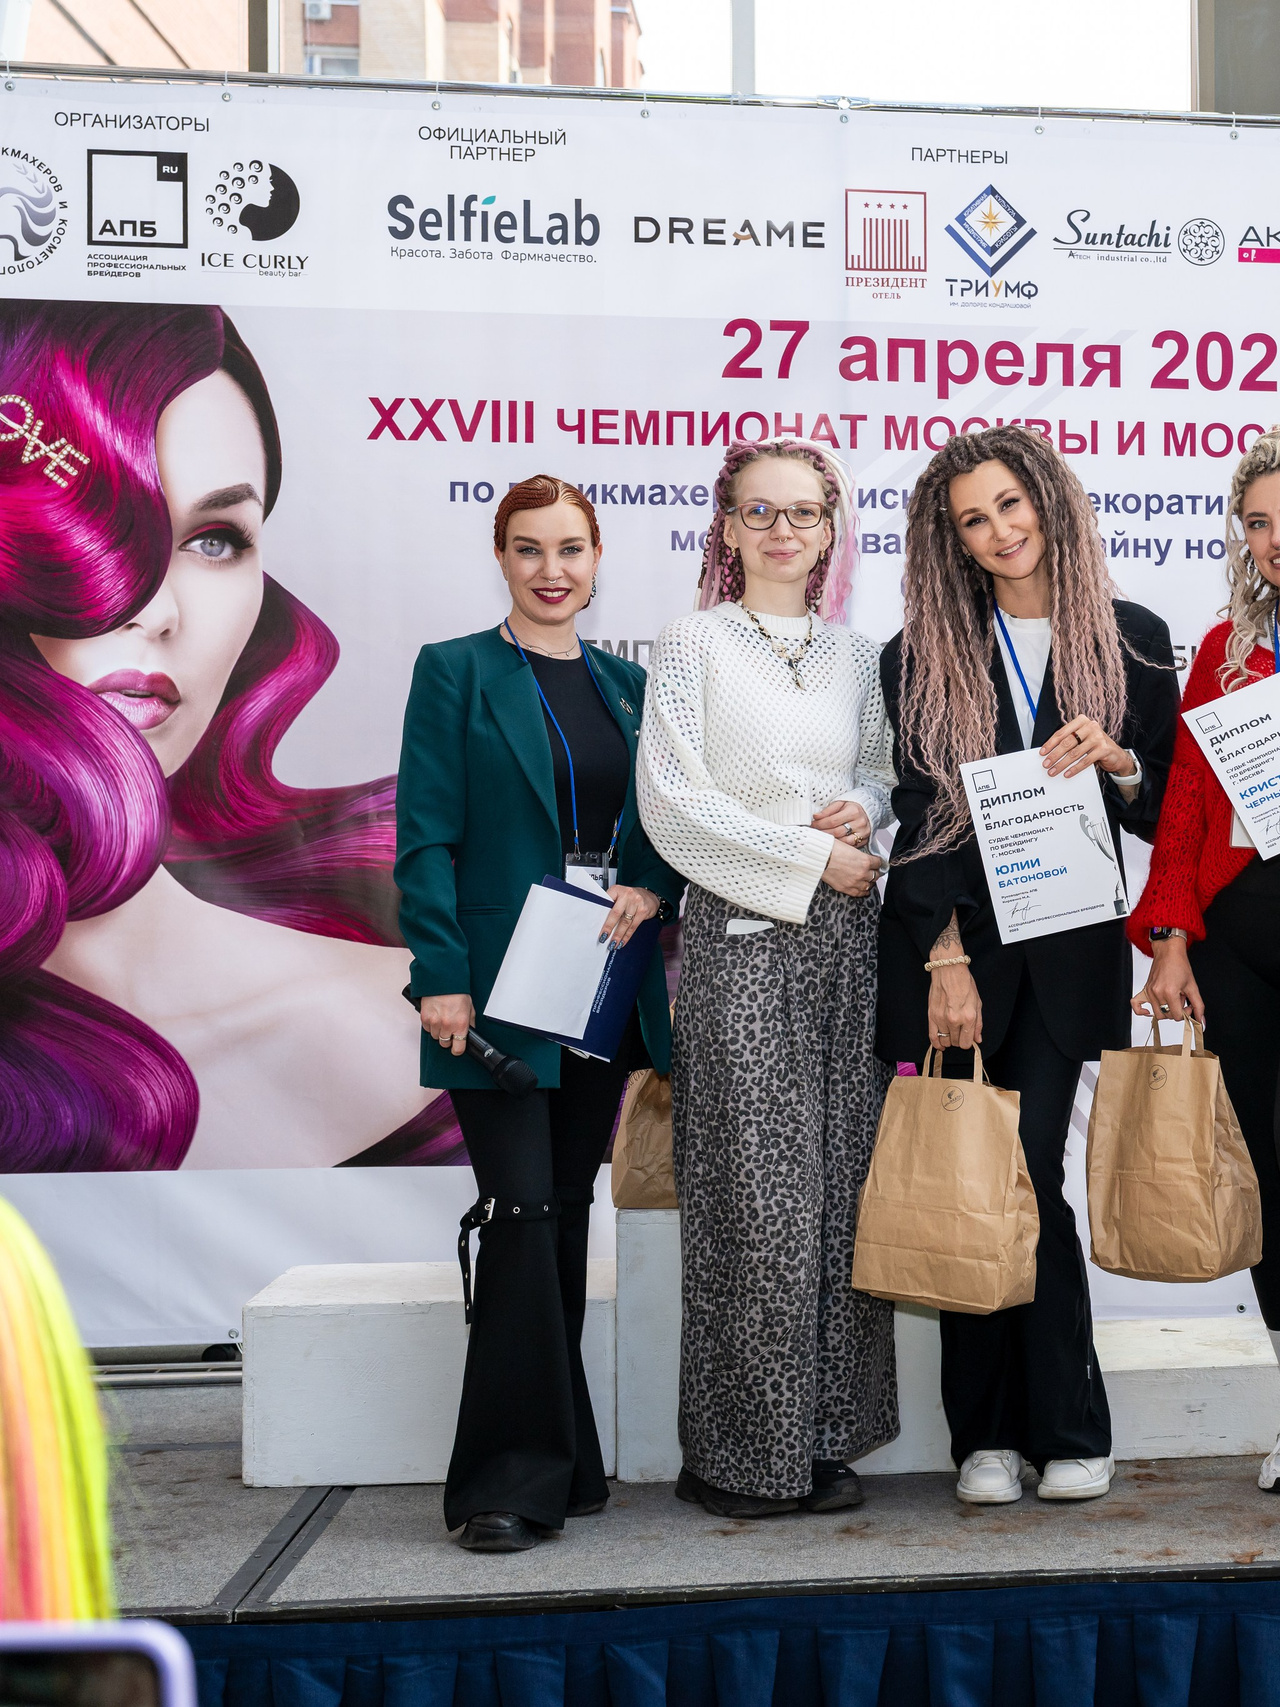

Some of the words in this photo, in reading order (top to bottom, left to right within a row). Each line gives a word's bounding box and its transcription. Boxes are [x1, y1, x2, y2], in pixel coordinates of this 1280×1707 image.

[55, 112, 209, 132] ОРГАНИЗАТОРЫ
[419, 126, 566, 145] ОФИЦИАЛЬНЫЙ
[451, 145, 535, 162] ПАРТНЕР
[912, 147, 1007, 164] ПАРТНЕРЫ
[1, 146, 63, 193] КМАХЕРОВ
[161, 165, 179, 174] RU
[58, 201, 68, 209] И
[99, 220, 157, 237] АПБ
[388, 194, 600, 246] SelfieLab
[1052, 208, 1172, 249] Suntachi
[634, 216, 825, 248] DREAME
[0, 218, 68, 275] КОСМЕТОЛОГ
[391, 247, 444, 259] Красота.
[501, 250, 596, 263] Фармкачество.
[87, 262, 186, 270] ПРОФЕССИОНАЛЬНЫХ
[202, 253, 234, 267] ICE
[243, 254, 308, 269] CURLY
[1097, 254, 1137, 262] industrial
[259, 269, 286, 278] beauty
[845, 277, 927, 289] ПРЕЗИДЕНТ
[944, 278, 1039, 300] ТРИУМФ
[872, 291, 902, 300] ОТЕЛЬ
[722, 318, 809, 379] 27
[839, 336, 1121, 399] апреля
[367, 397, 534, 443] XXVIII
[555, 406, 868, 450] ЧЕМПИОНАТ
[1118, 421, 1145, 456] И
[450, 482, 494, 503] по
[1209, 713, 1272, 748] ДИПЛОМ
[1214, 747, 1223, 755] И
[1226, 762, 1246, 774] СУДЬЕ
[1238, 756, 1275, 776] БРЕЙДИНГУ
[1238, 769, 1265, 783] МОСКВА
[980, 786, 1045, 811] ДИПЛОМ
[982, 812, 991, 821] И
[985, 803, 1085, 831] БЛАГОДАРНОСТЬ
[988, 835, 1010, 844] СУДЬЕ
[1010, 826, 1054, 839] ЧЕМПИОНАТА
[1000, 837, 1038, 849] БРЕЙДИНГУ
[998, 847, 1026, 857] МОСКВА
[995, 858, 1041, 876] ЮЛИИ
[998, 866, 1068, 889] БАТОНОВОЙ
